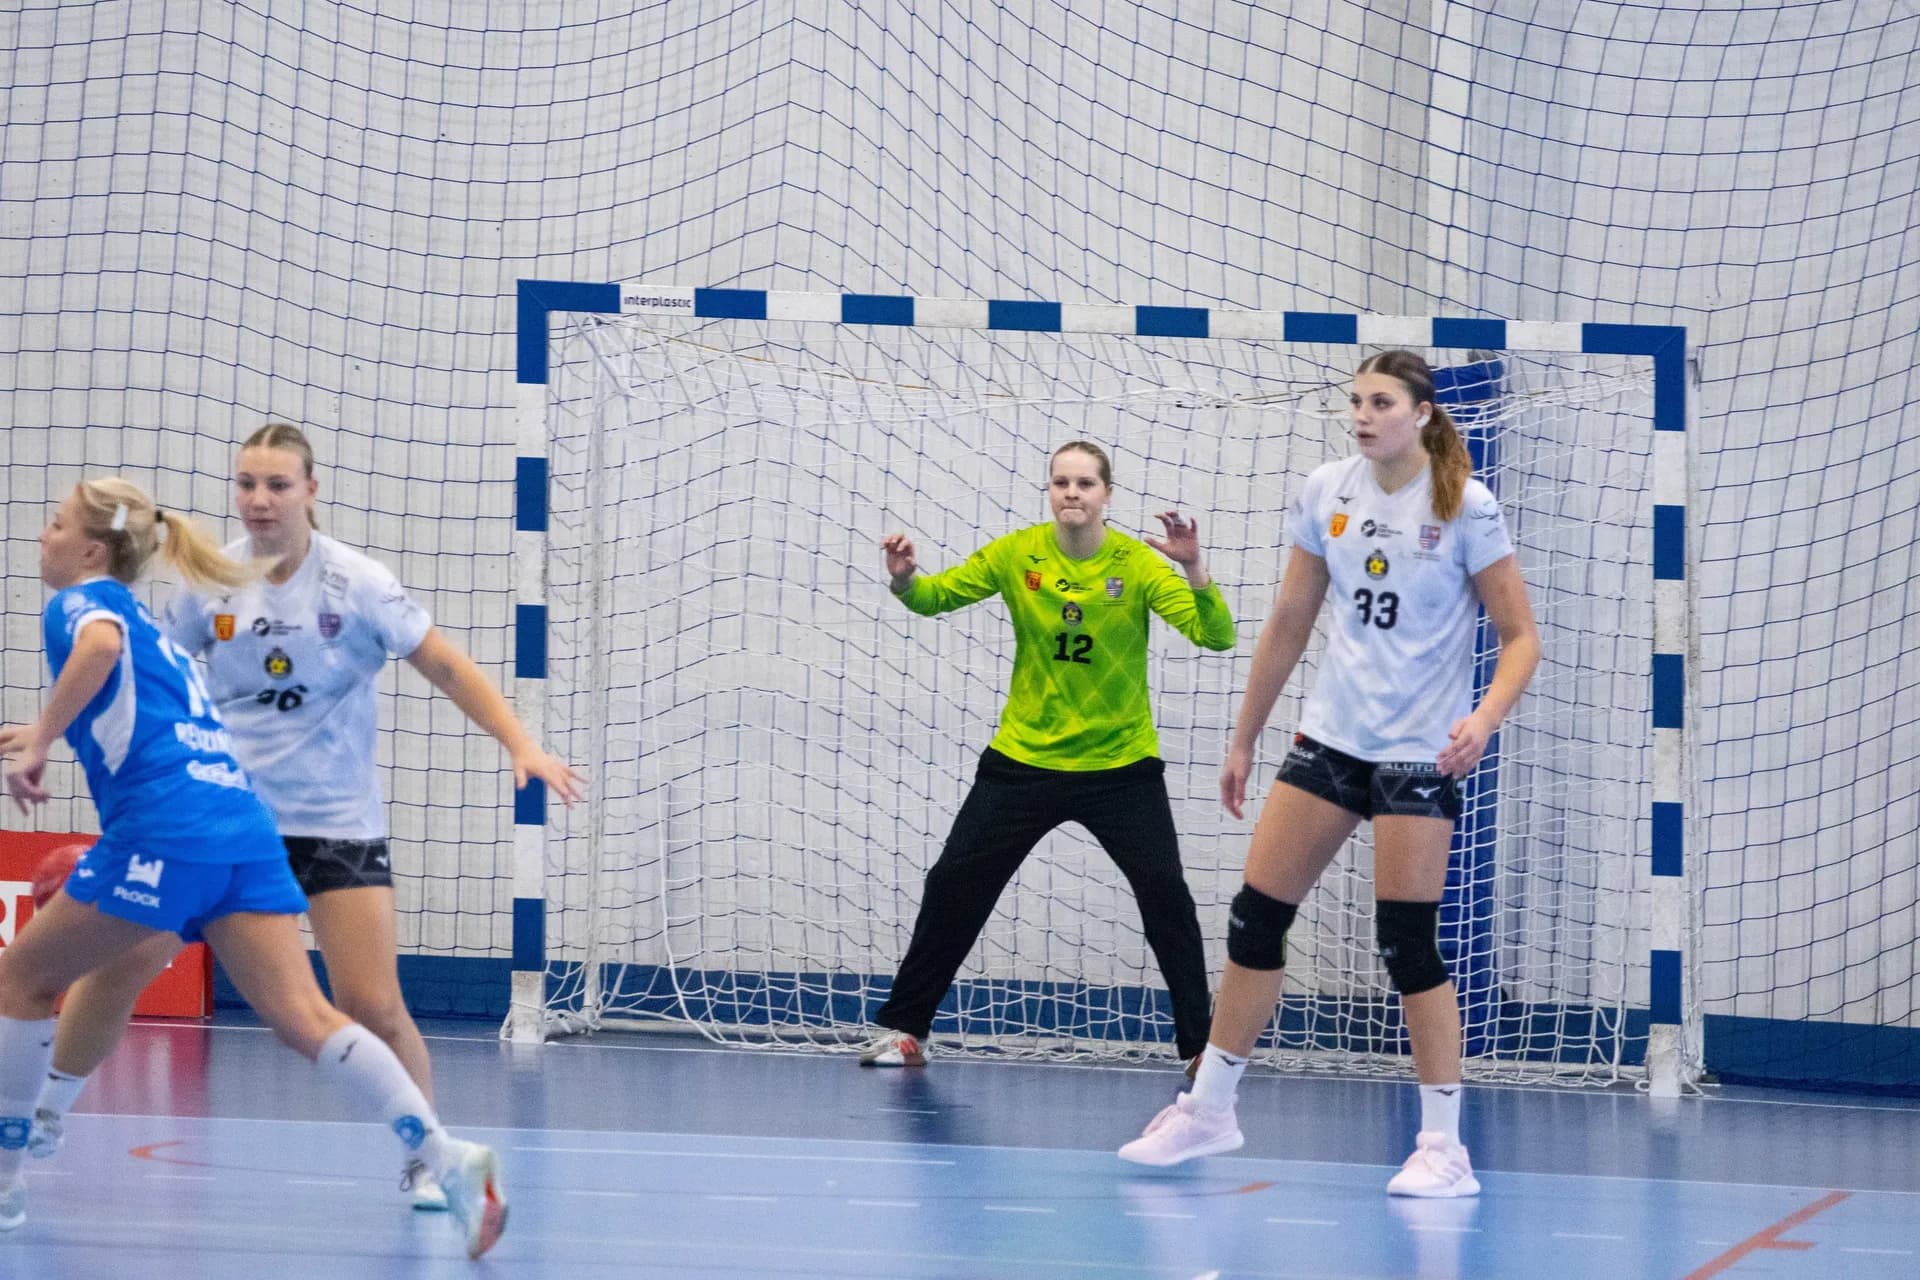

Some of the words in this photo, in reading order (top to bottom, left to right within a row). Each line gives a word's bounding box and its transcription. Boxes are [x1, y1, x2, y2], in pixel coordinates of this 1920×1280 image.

[624, 295, 691, 308] interplastic
[1354, 588, 1399, 630] 33
[1053, 632, 1093, 664] 12
